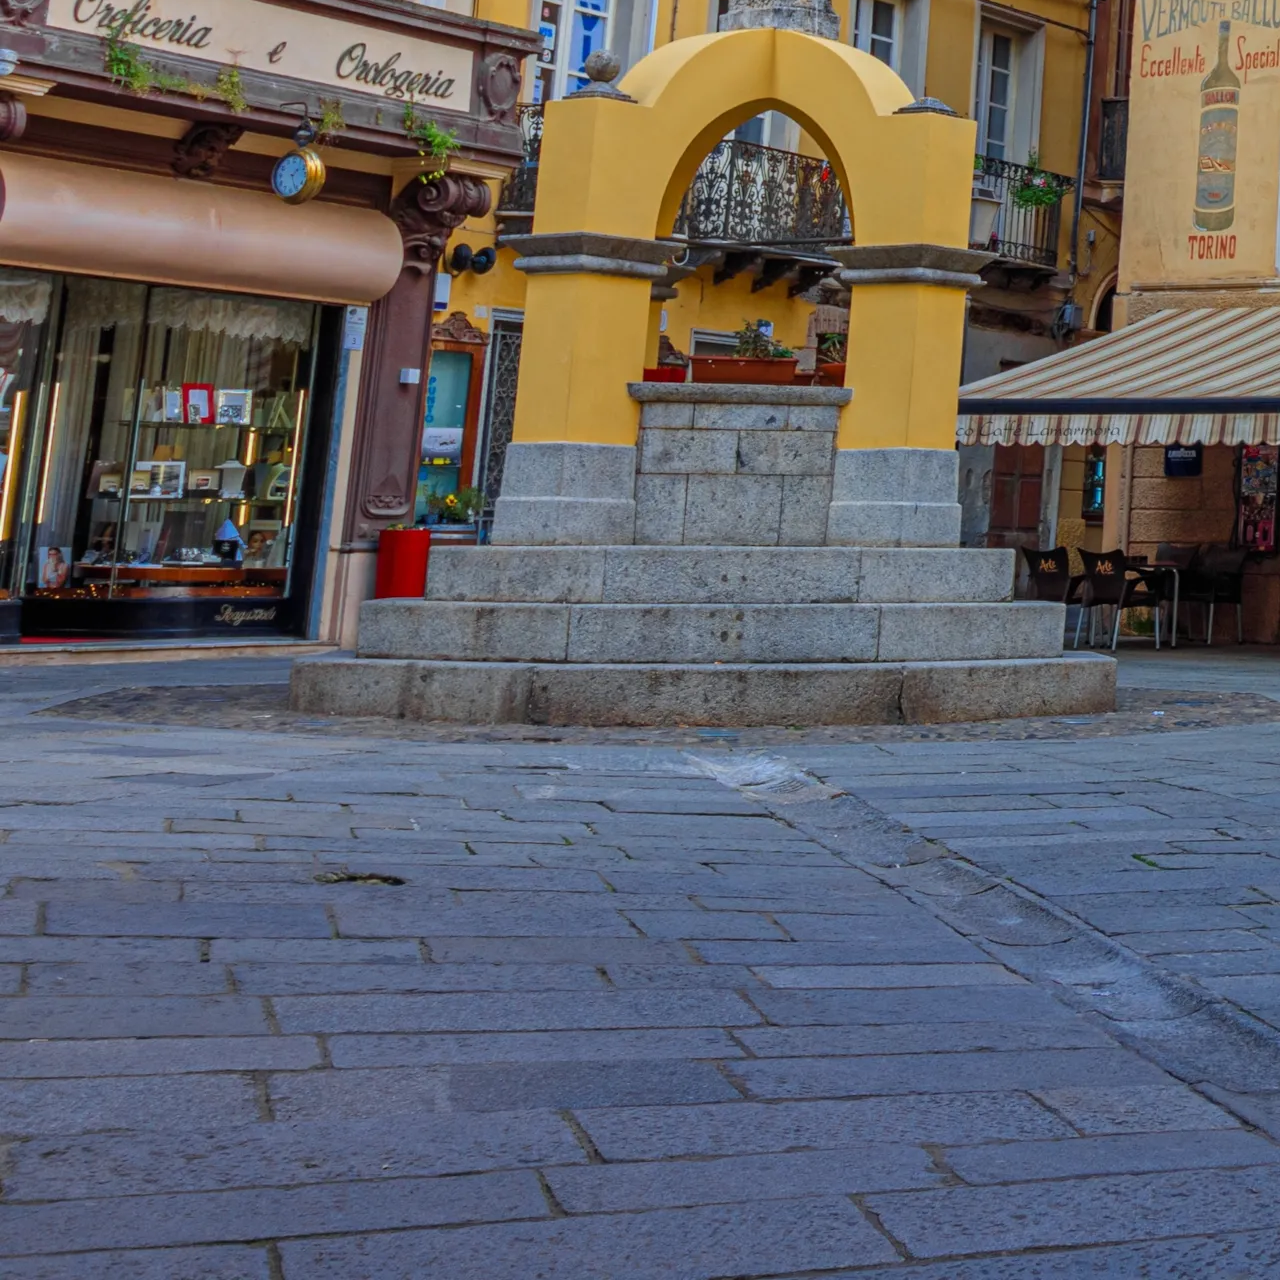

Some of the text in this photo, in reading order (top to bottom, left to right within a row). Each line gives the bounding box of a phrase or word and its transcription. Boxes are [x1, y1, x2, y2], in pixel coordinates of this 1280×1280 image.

[267, 40, 287, 64] e
[335, 42, 456, 101] Orologeria
[1140, 43, 1206, 78] Eccellente
[1188, 234, 1237, 260] TORINO
[1028, 421, 1121, 437] Lamarmora
